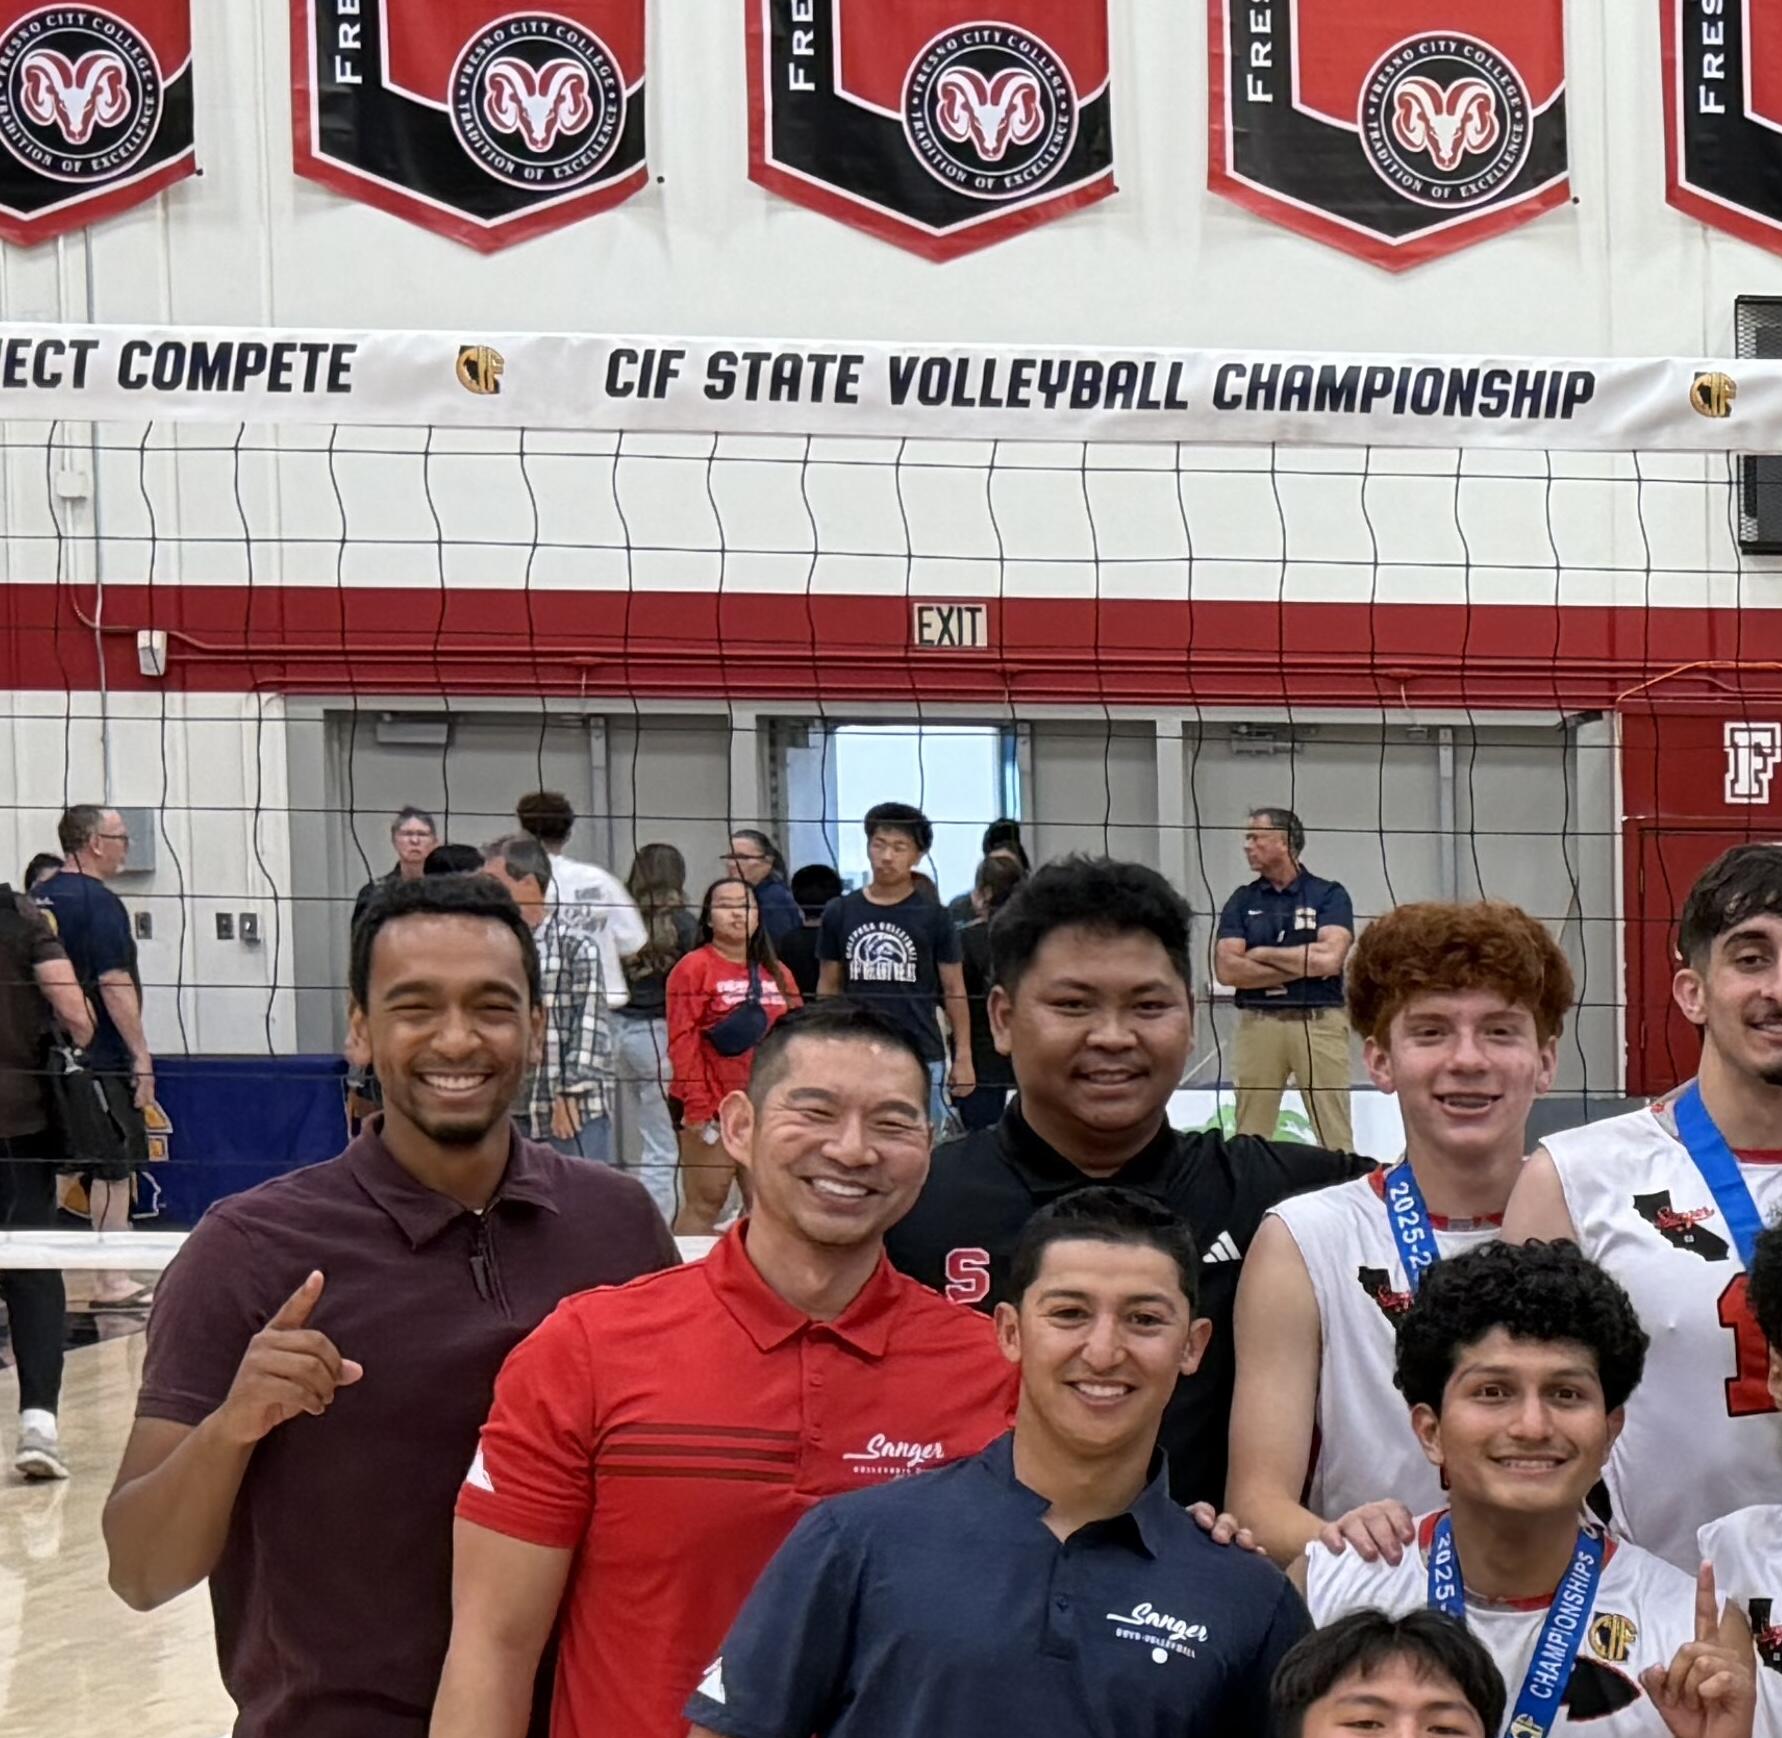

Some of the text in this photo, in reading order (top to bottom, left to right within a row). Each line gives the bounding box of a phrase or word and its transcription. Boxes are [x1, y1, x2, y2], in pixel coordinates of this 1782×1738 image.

[912, 33, 1065, 99] FRESNO CITY COLLEGE
[1247, 0, 1274, 103] FRE
[1368, 42, 1520, 107] FRESNO CITY COLLEGE
[910, 112, 1068, 189] TRADITION OF EXCELLENCE
[1366, 121, 1524, 198] TRADITION OF EXCELLENCE
[0, 339, 356, 392] ECT COMPETE
[606, 349, 1594, 420] CIF STATE VOLLEYBALL CHAMPIONSHIP
[917, 607, 982, 647] EXIT
[946, 1247, 990, 1303] S
[842, 1433, 944, 1467] Sanger
[1106, 1602, 1208, 1642] Sanger
[1530, 1551, 1595, 1699] CHAMPIONSHIPS
